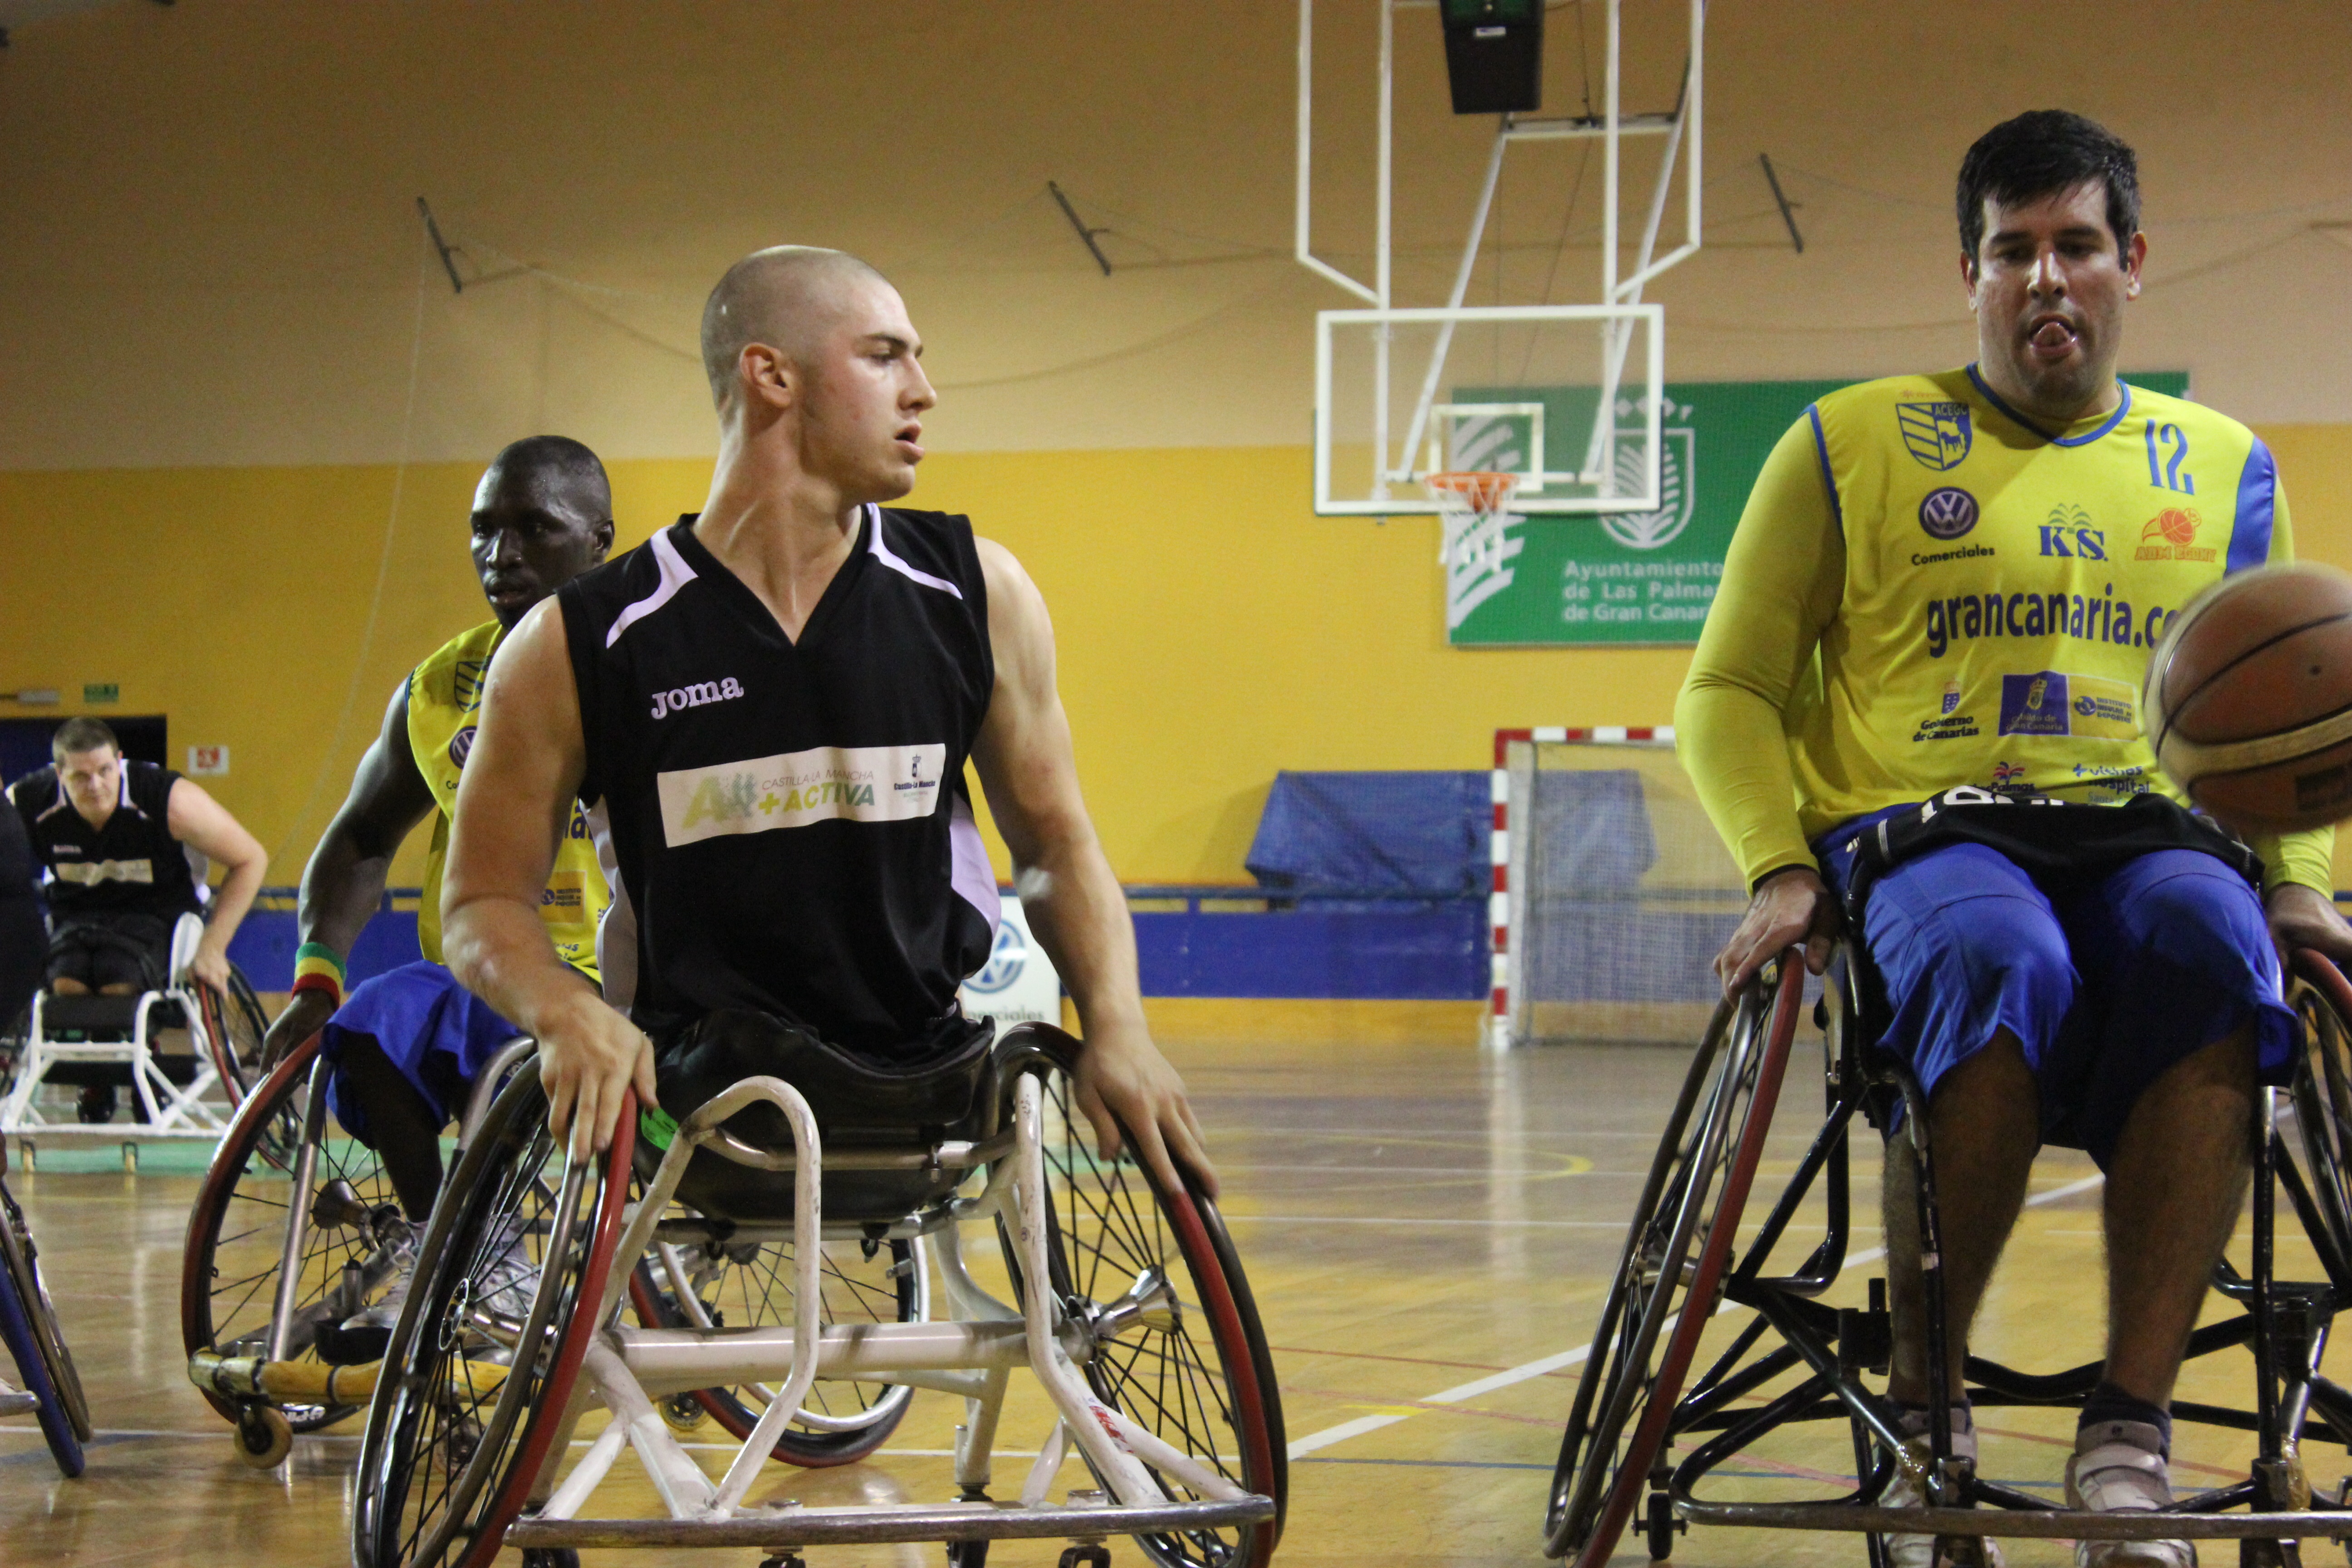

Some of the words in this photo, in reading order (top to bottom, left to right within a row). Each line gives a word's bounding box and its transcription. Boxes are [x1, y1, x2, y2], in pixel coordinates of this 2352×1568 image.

[2145, 418, 2195, 495] 12
[1911, 544, 1995, 566] Comerciales
[1564, 560, 1725, 581] Ayuntamiento
[1564, 582, 1589, 599] de
[1602, 582, 1637, 599] Las
[1564, 603, 1589, 621] de
[1594, 603, 1642, 621] Gran
[826, 769, 874, 781] MANCHA
